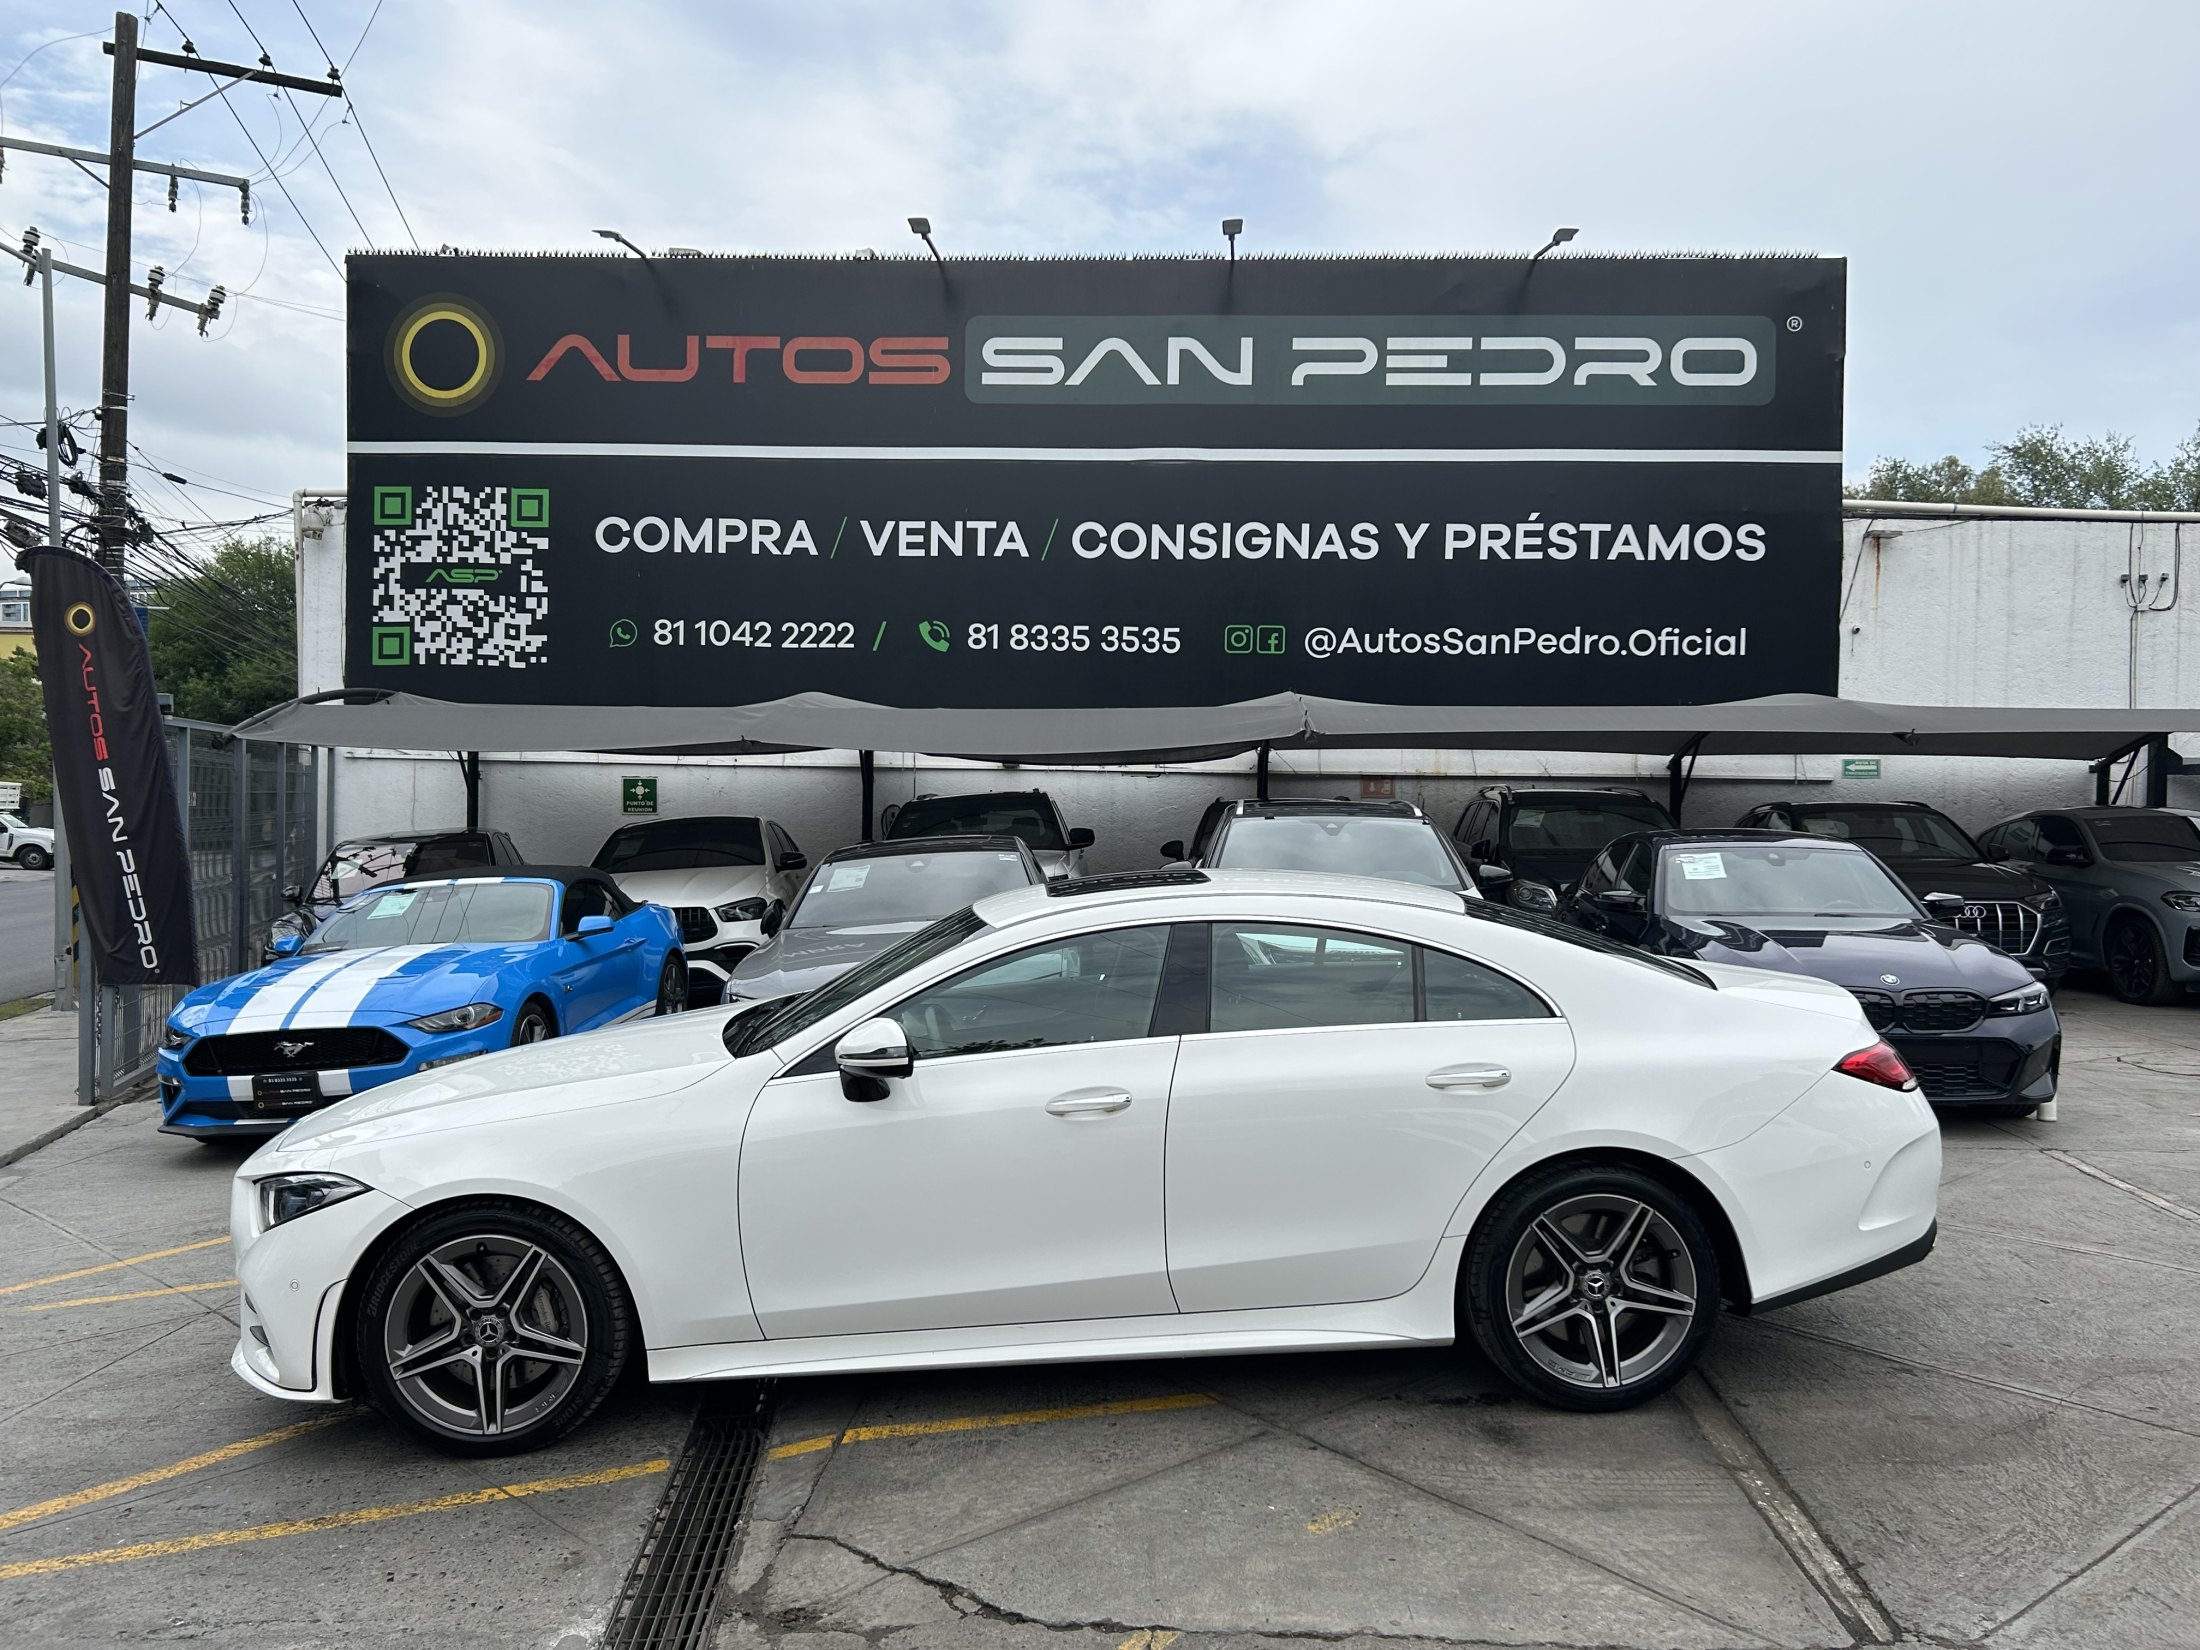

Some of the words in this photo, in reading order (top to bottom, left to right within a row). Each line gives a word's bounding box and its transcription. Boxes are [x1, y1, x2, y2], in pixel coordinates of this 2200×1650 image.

[527, 334, 949, 385] AUTOS
[981, 336, 1254, 387] SAN
[1291, 336, 1758, 387] PEDRO
[595, 515, 819, 556] COMPRA
[859, 519, 1030, 558] VENTA
[1071, 521, 1380, 561] CONSIGNAS
[1394, 522, 1431, 560] Y
[1444, 512, 1766, 562] PRÉSTAMOS
[426, 568, 499, 584] ASP
[653, 618, 685, 646] 81
[694, 619, 772, 648] 1042
[781, 621, 855, 649] 2222
[967, 622, 999, 650] 81
[1009, 623, 1090, 652] 8335
[1100, 625, 1181, 654] 3535
[1304, 626, 1747, 659] @AutosSanPedro.Oficial
[79, 643, 108, 761] AUTOS
[98, 766, 129, 843] SAN
[116, 849, 159, 970] PEDRO
